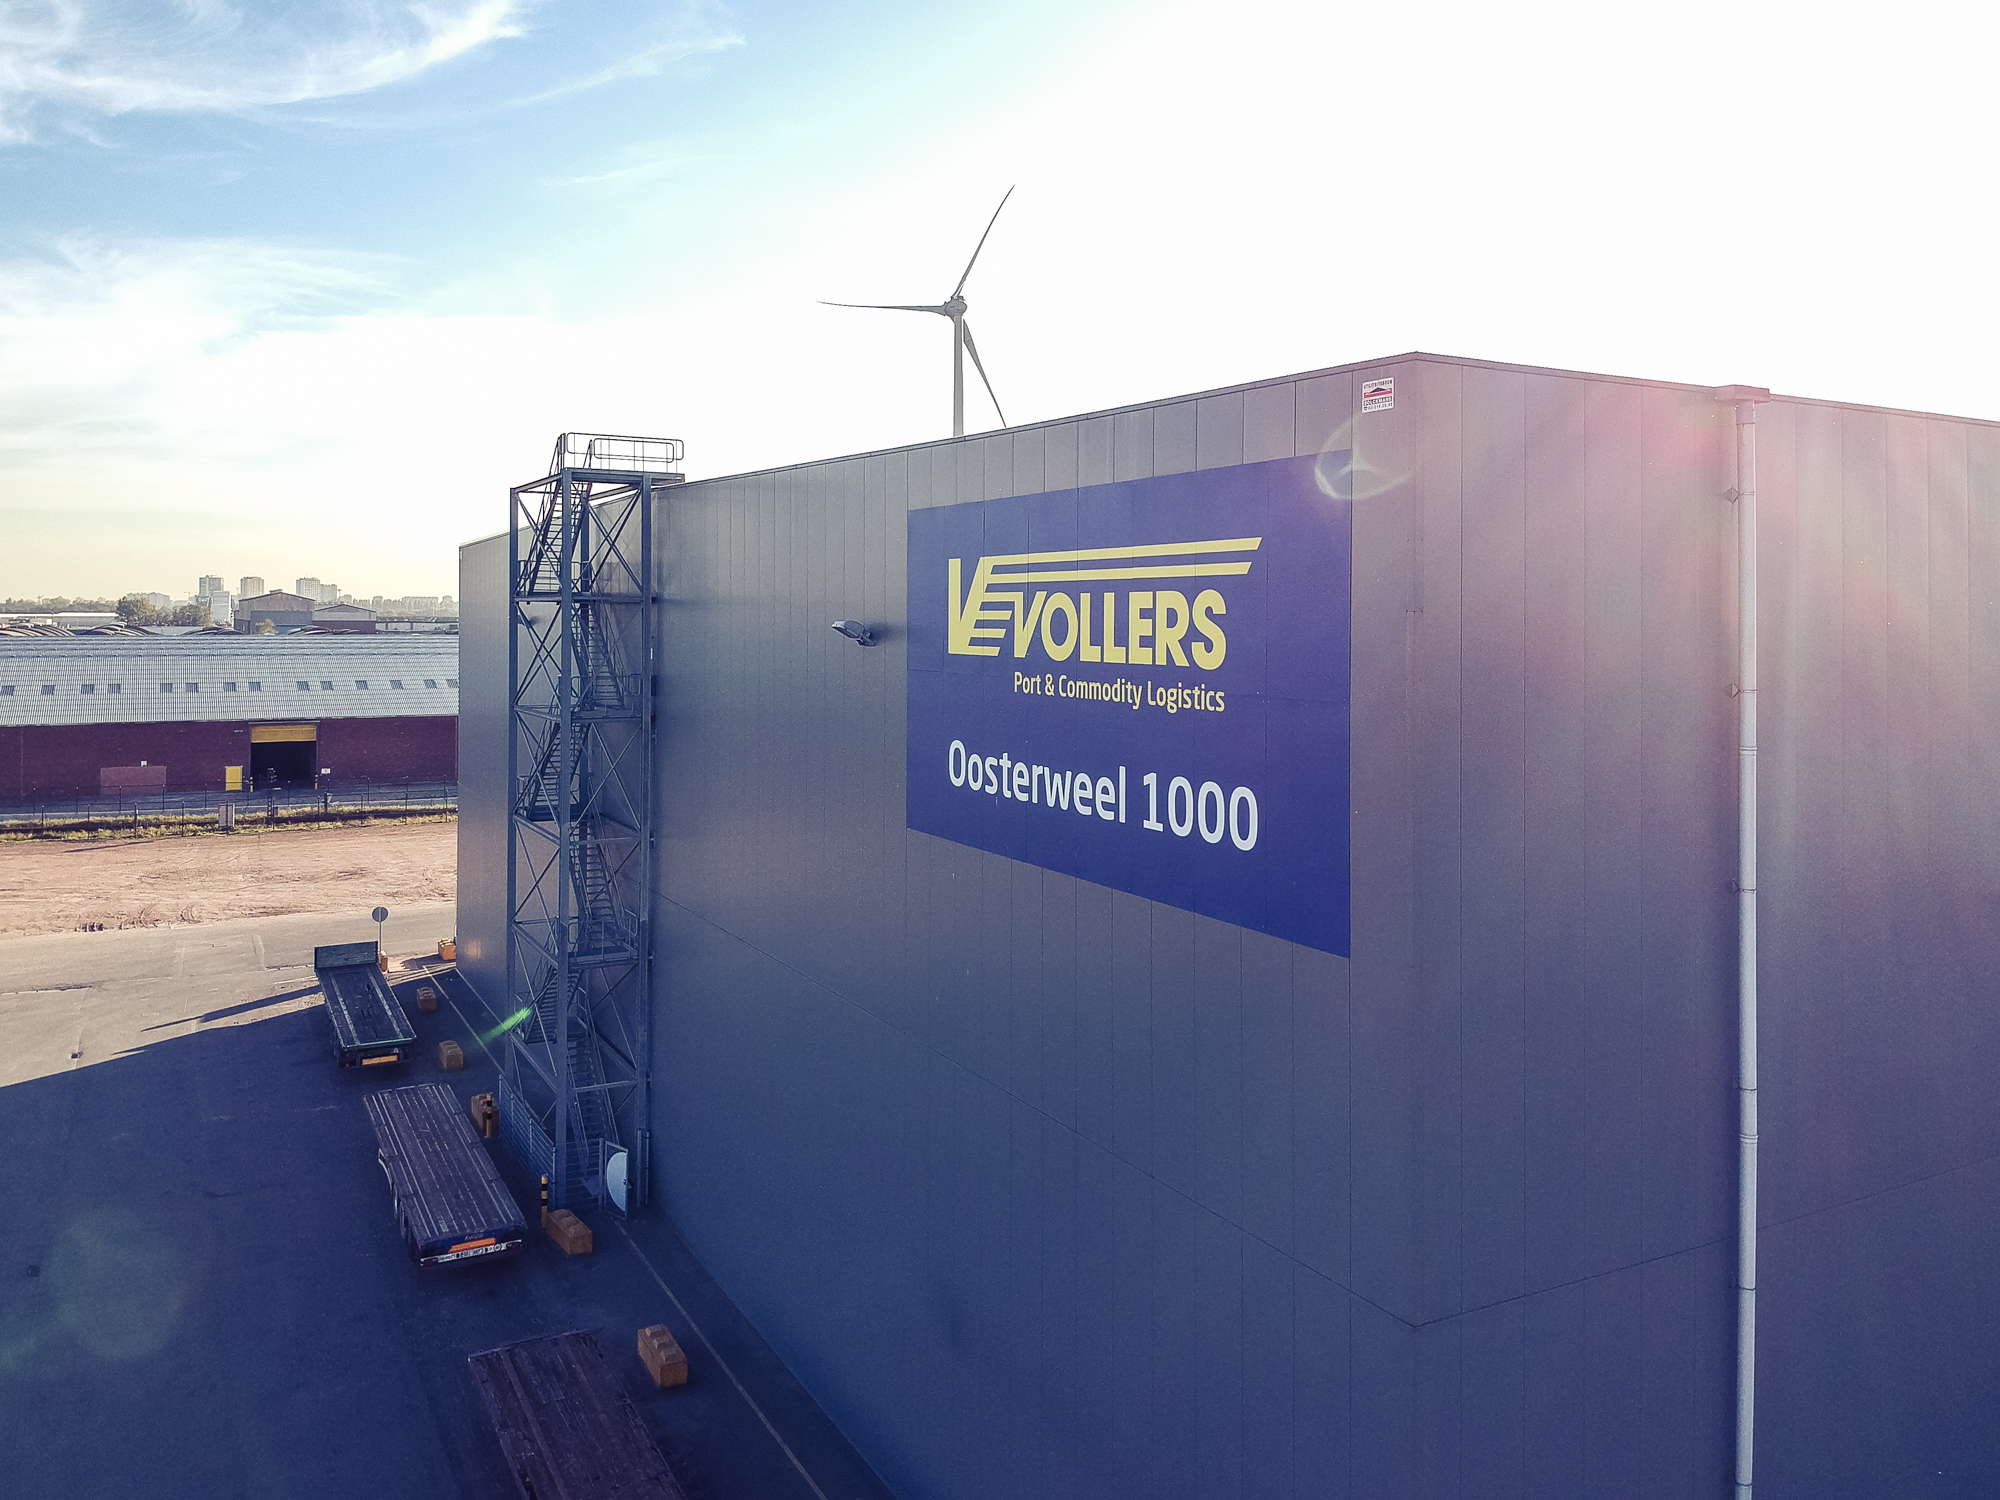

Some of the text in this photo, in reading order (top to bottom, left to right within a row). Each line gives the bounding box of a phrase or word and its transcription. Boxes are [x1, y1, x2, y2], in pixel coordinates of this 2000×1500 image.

[1012, 589, 1228, 670] VOLLERS
[1013, 671, 1225, 713] Port & Commodity Logistics
[948, 739, 1259, 851] Oosterweel 1000
